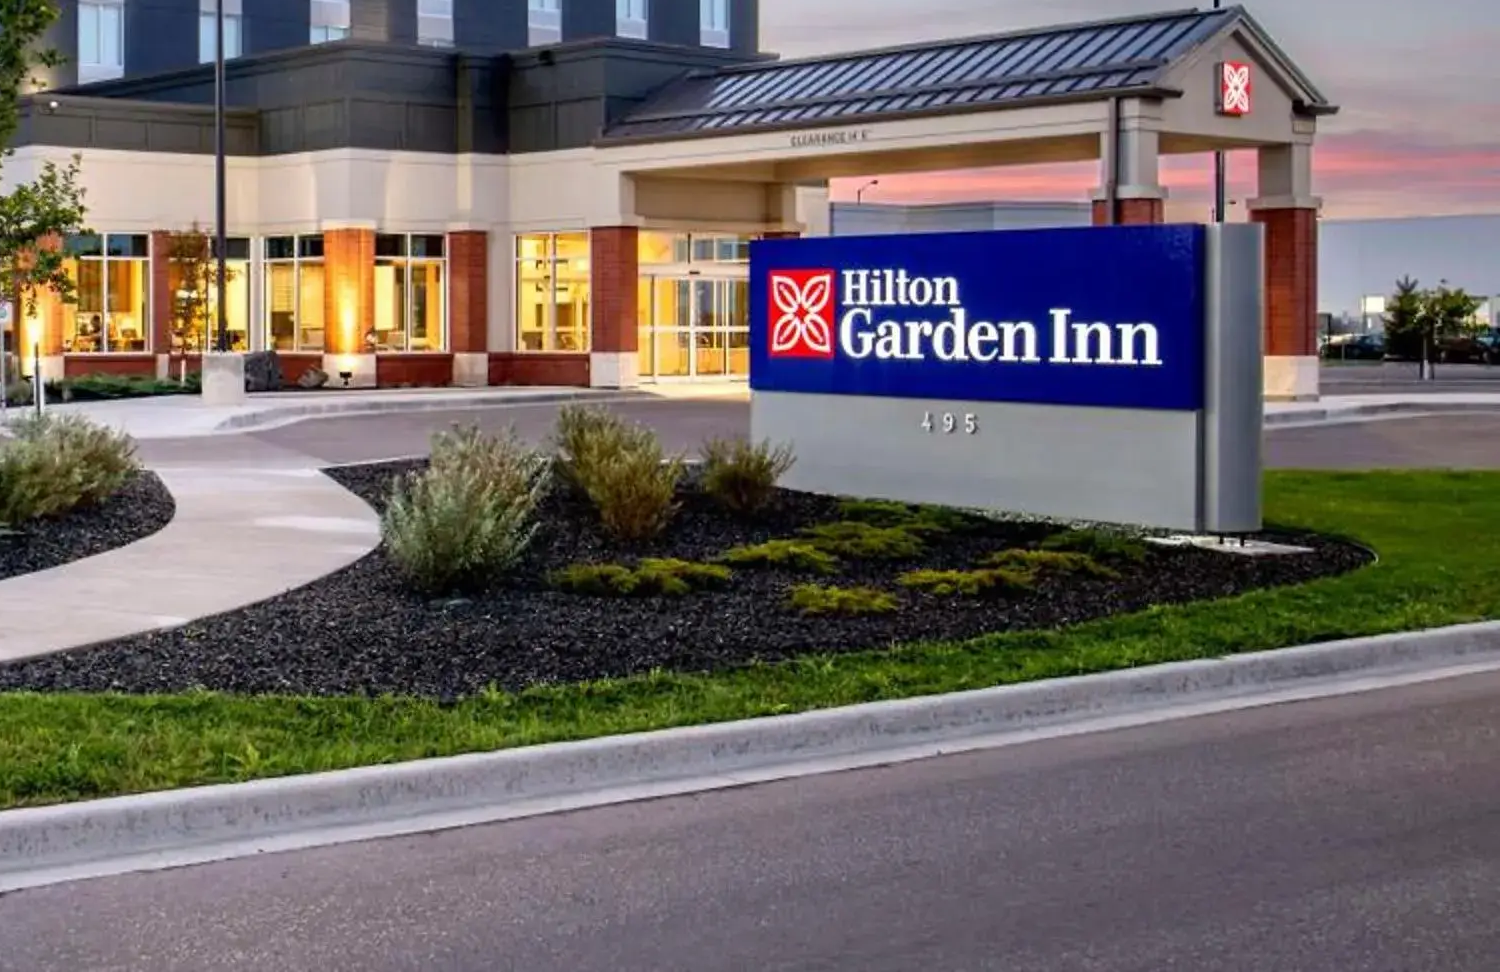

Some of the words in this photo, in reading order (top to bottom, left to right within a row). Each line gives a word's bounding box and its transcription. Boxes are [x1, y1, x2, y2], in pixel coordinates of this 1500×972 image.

[841, 269, 961, 306] Hilton
[840, 308, 1041, 362] Garden
[1048, 309, 1163, 365] Inn
